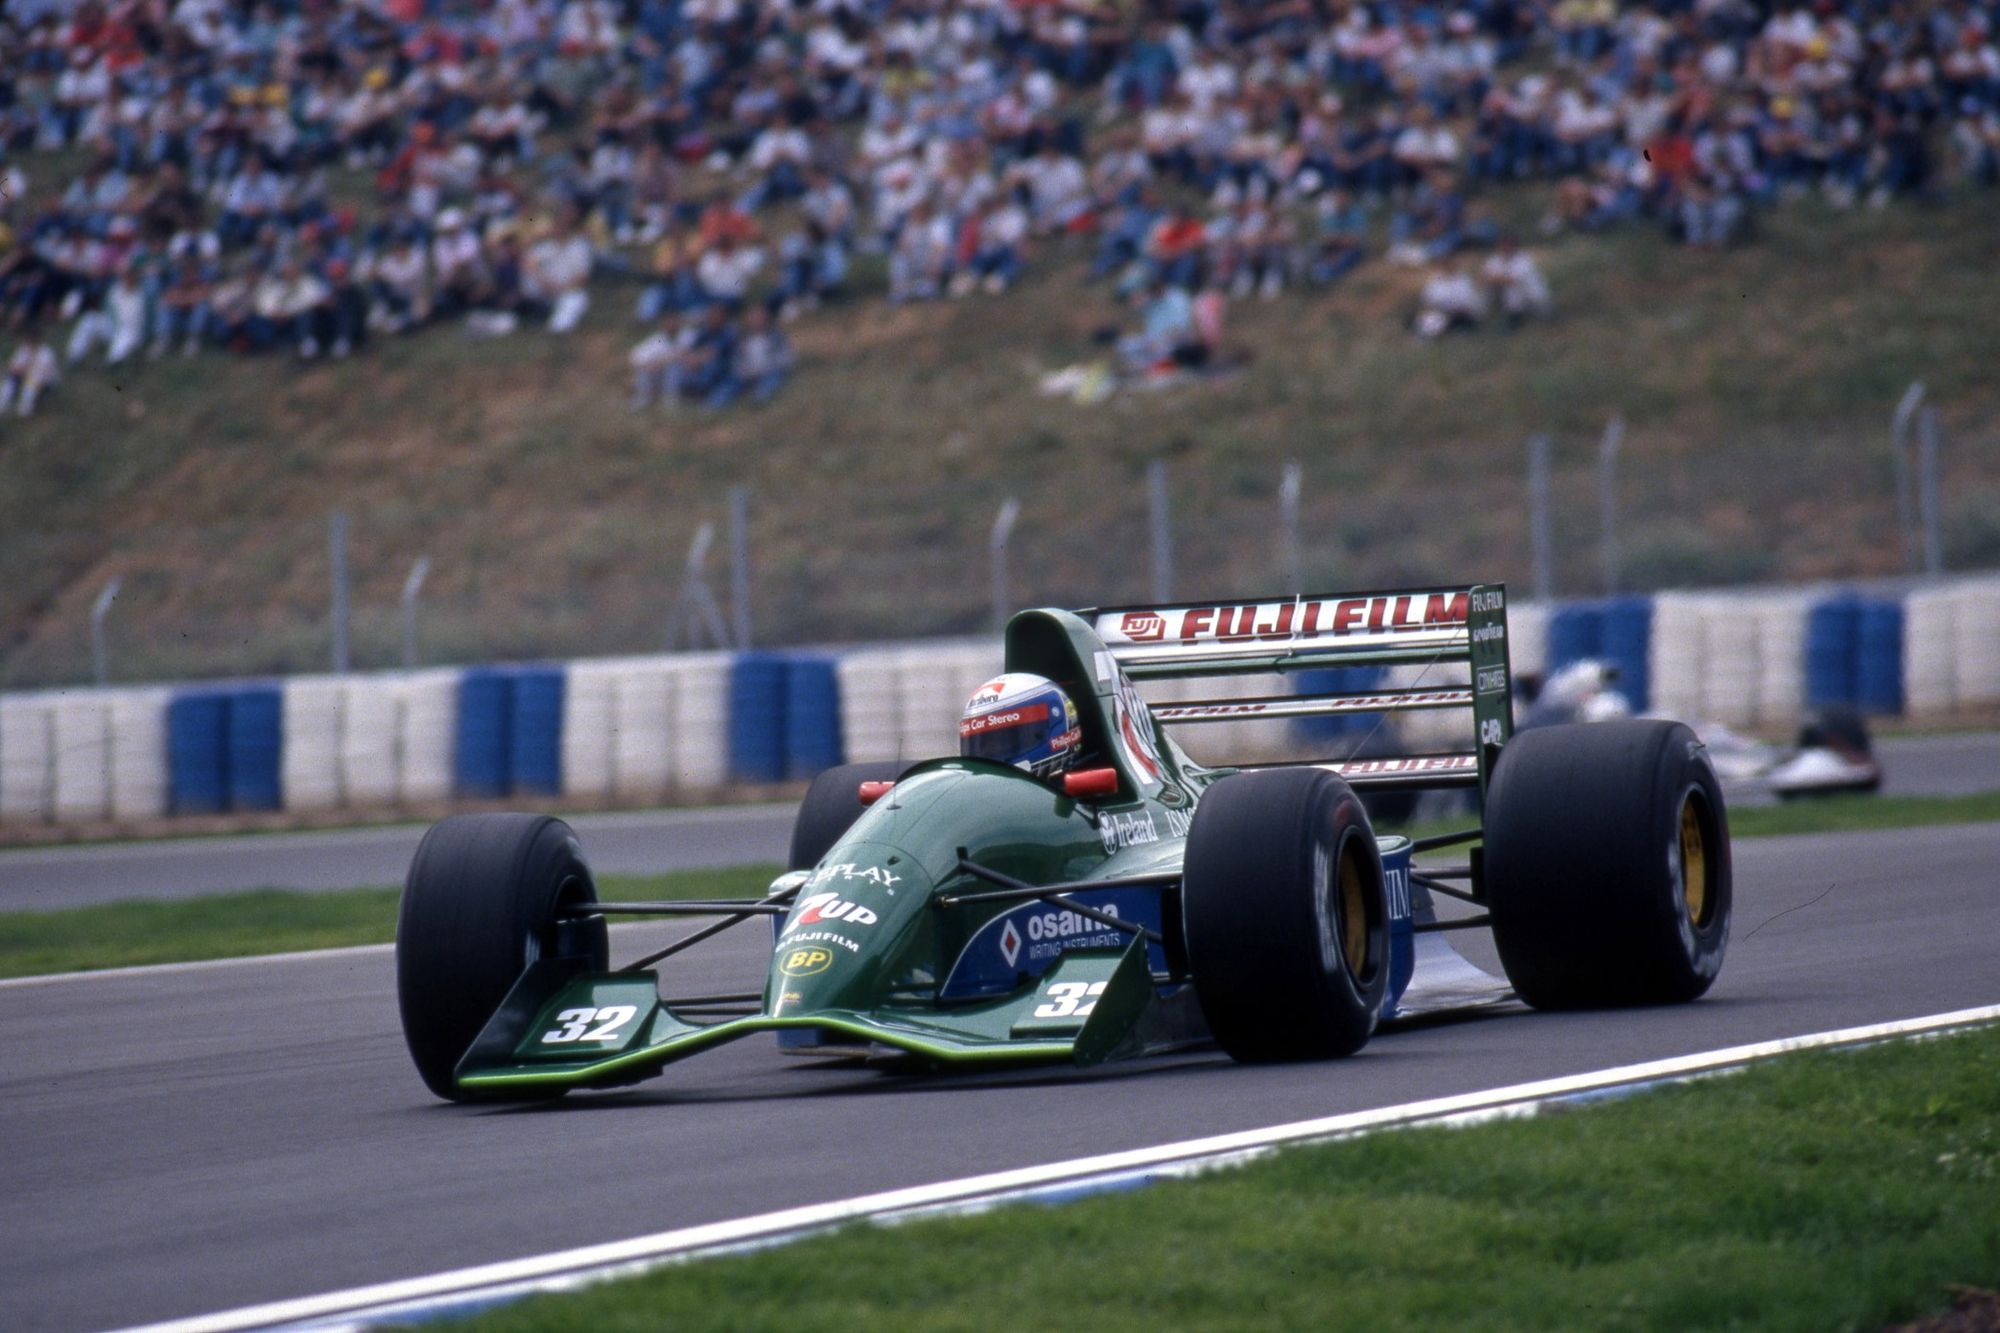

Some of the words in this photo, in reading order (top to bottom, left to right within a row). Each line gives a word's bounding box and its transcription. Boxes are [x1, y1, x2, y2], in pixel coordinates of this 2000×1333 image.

[1180, 592, 1469, 646] FUJIFILM
[1333, 692, 1472, 707] FUJIFIL
[971, 719, 985, 731] Car
[988, 713, 1020, 726] Stereo
[1339, 756, 1476, 774] FUJIFIL
[813, 862, 902, 887] EPLAY
[786, 951, 826, 969] BP
[541, 1005, 637, 1044] 32
